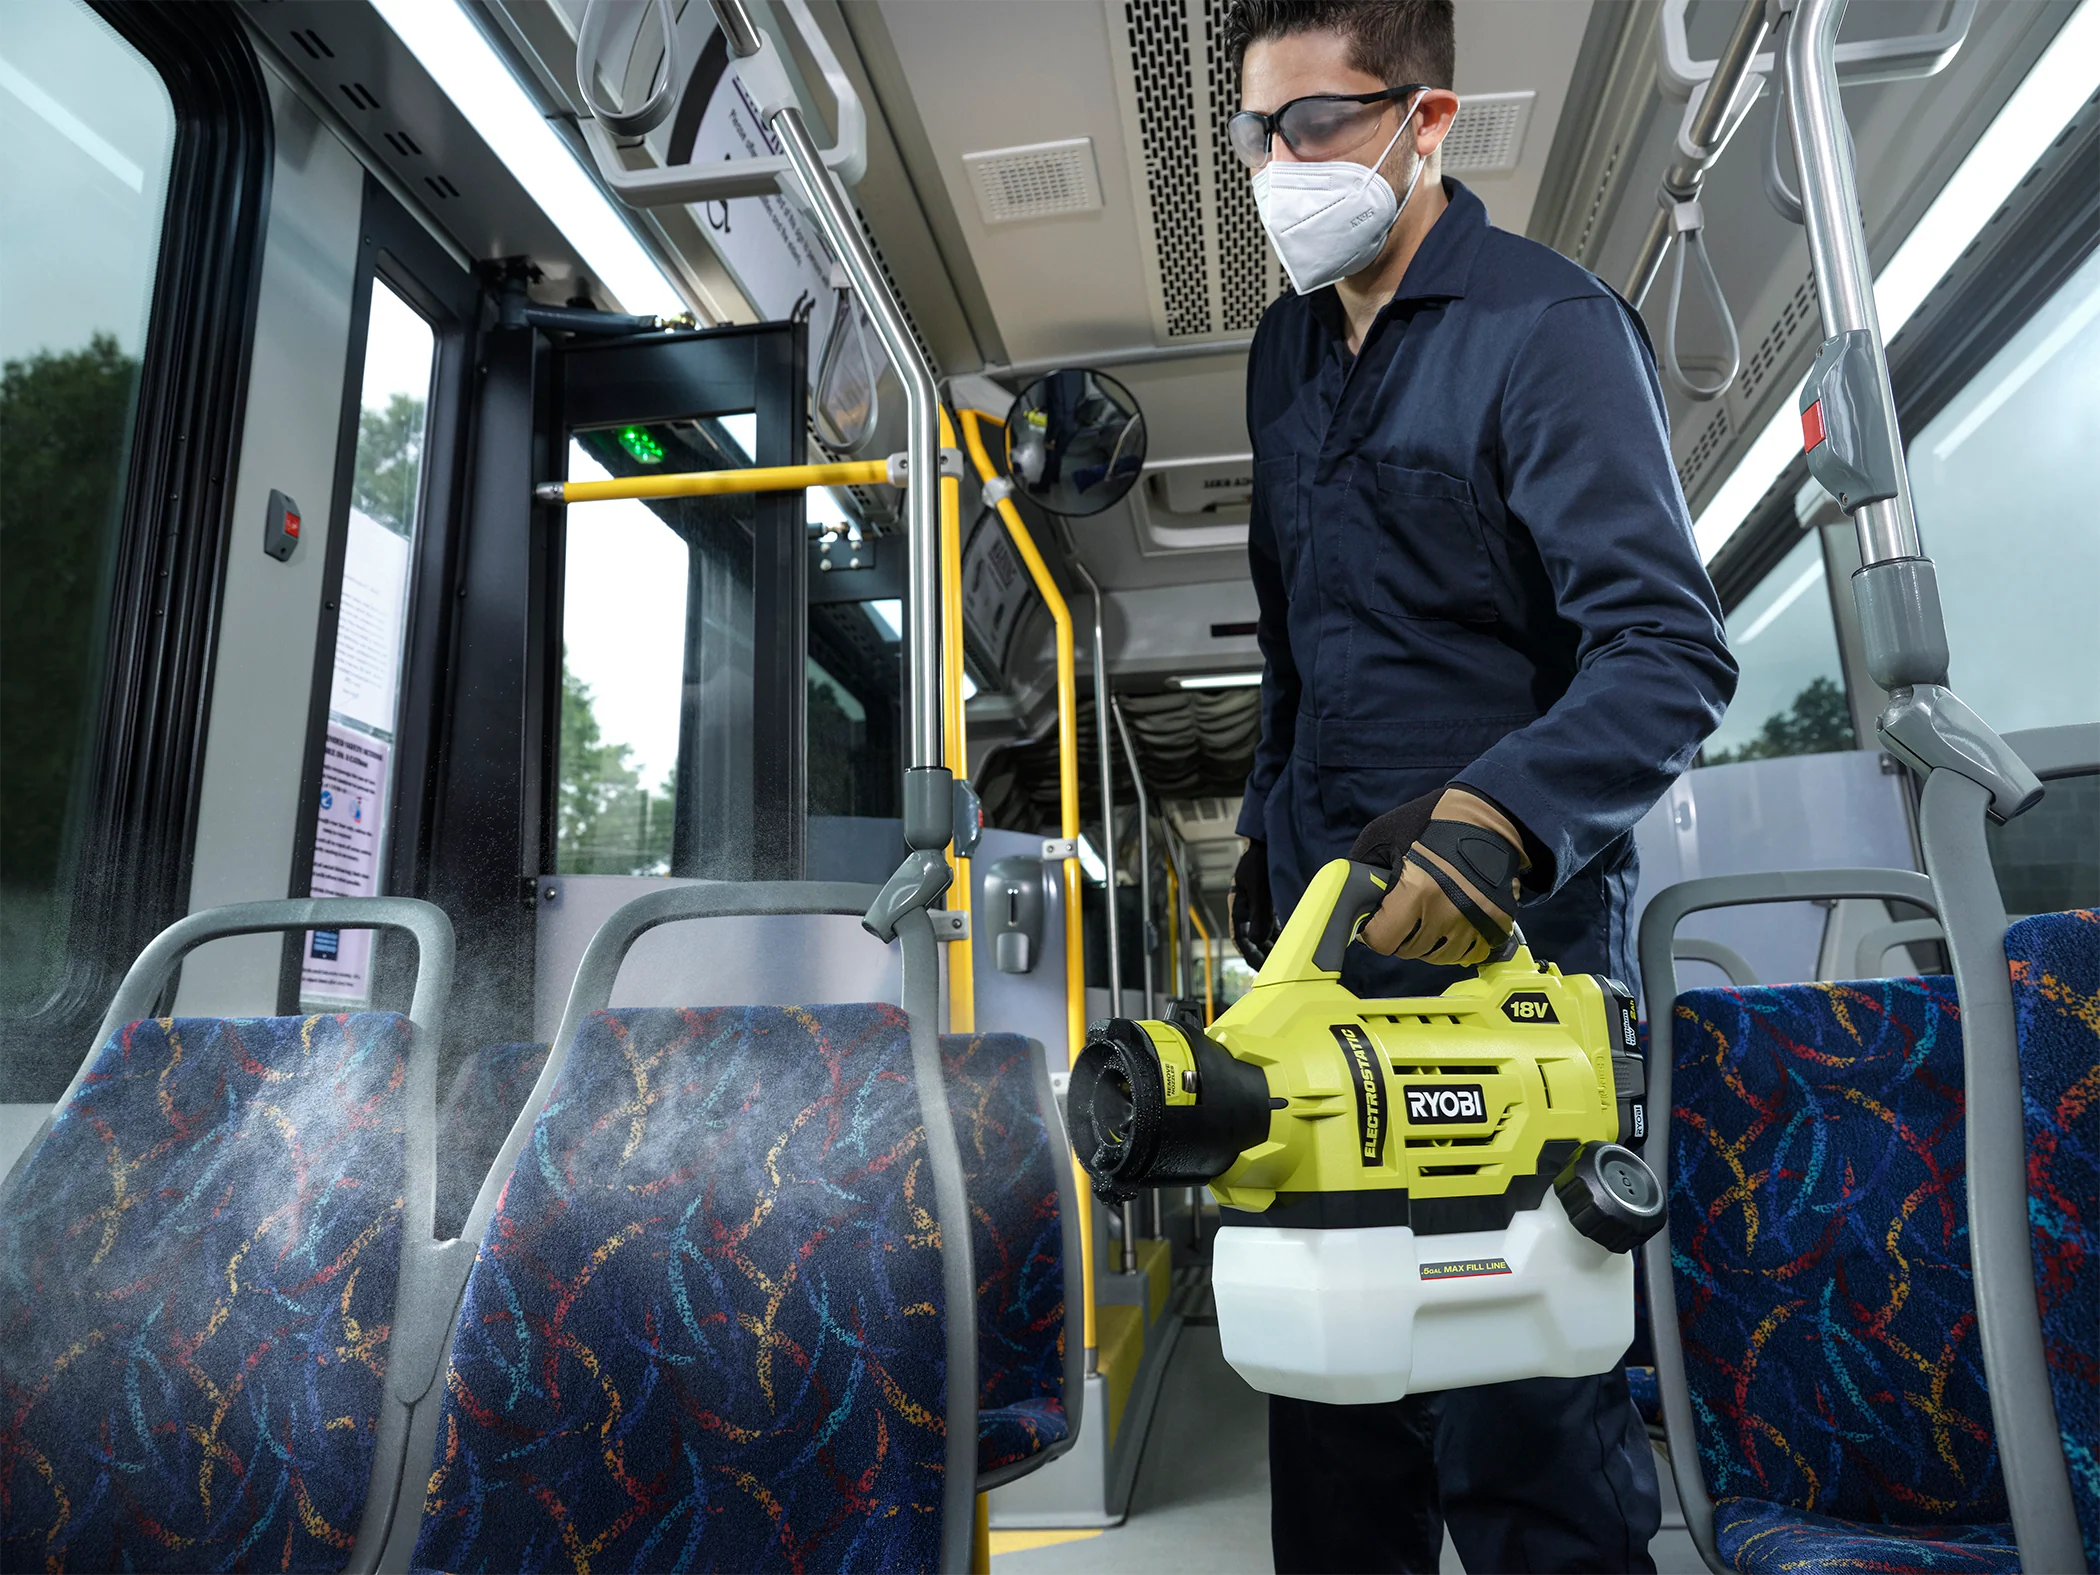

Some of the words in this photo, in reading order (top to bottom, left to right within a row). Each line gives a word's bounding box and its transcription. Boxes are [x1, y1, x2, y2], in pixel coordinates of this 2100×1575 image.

[1350, 207, 1374, 228] KN95
[1510, 1001, 1549, 1018] 18V
[1340, 1028, 1378, 1158] ELECTROSTATIC
[1407, 1091, 1482, 1117] RYOBI
[1635, 1106, 1643, 1135] RYOBI
[1443, 1265, 1465, 1273] MAX
[1466, 1263, 1485, 1271] FILL
[1486, 1261, 1507, 1270] LINE
